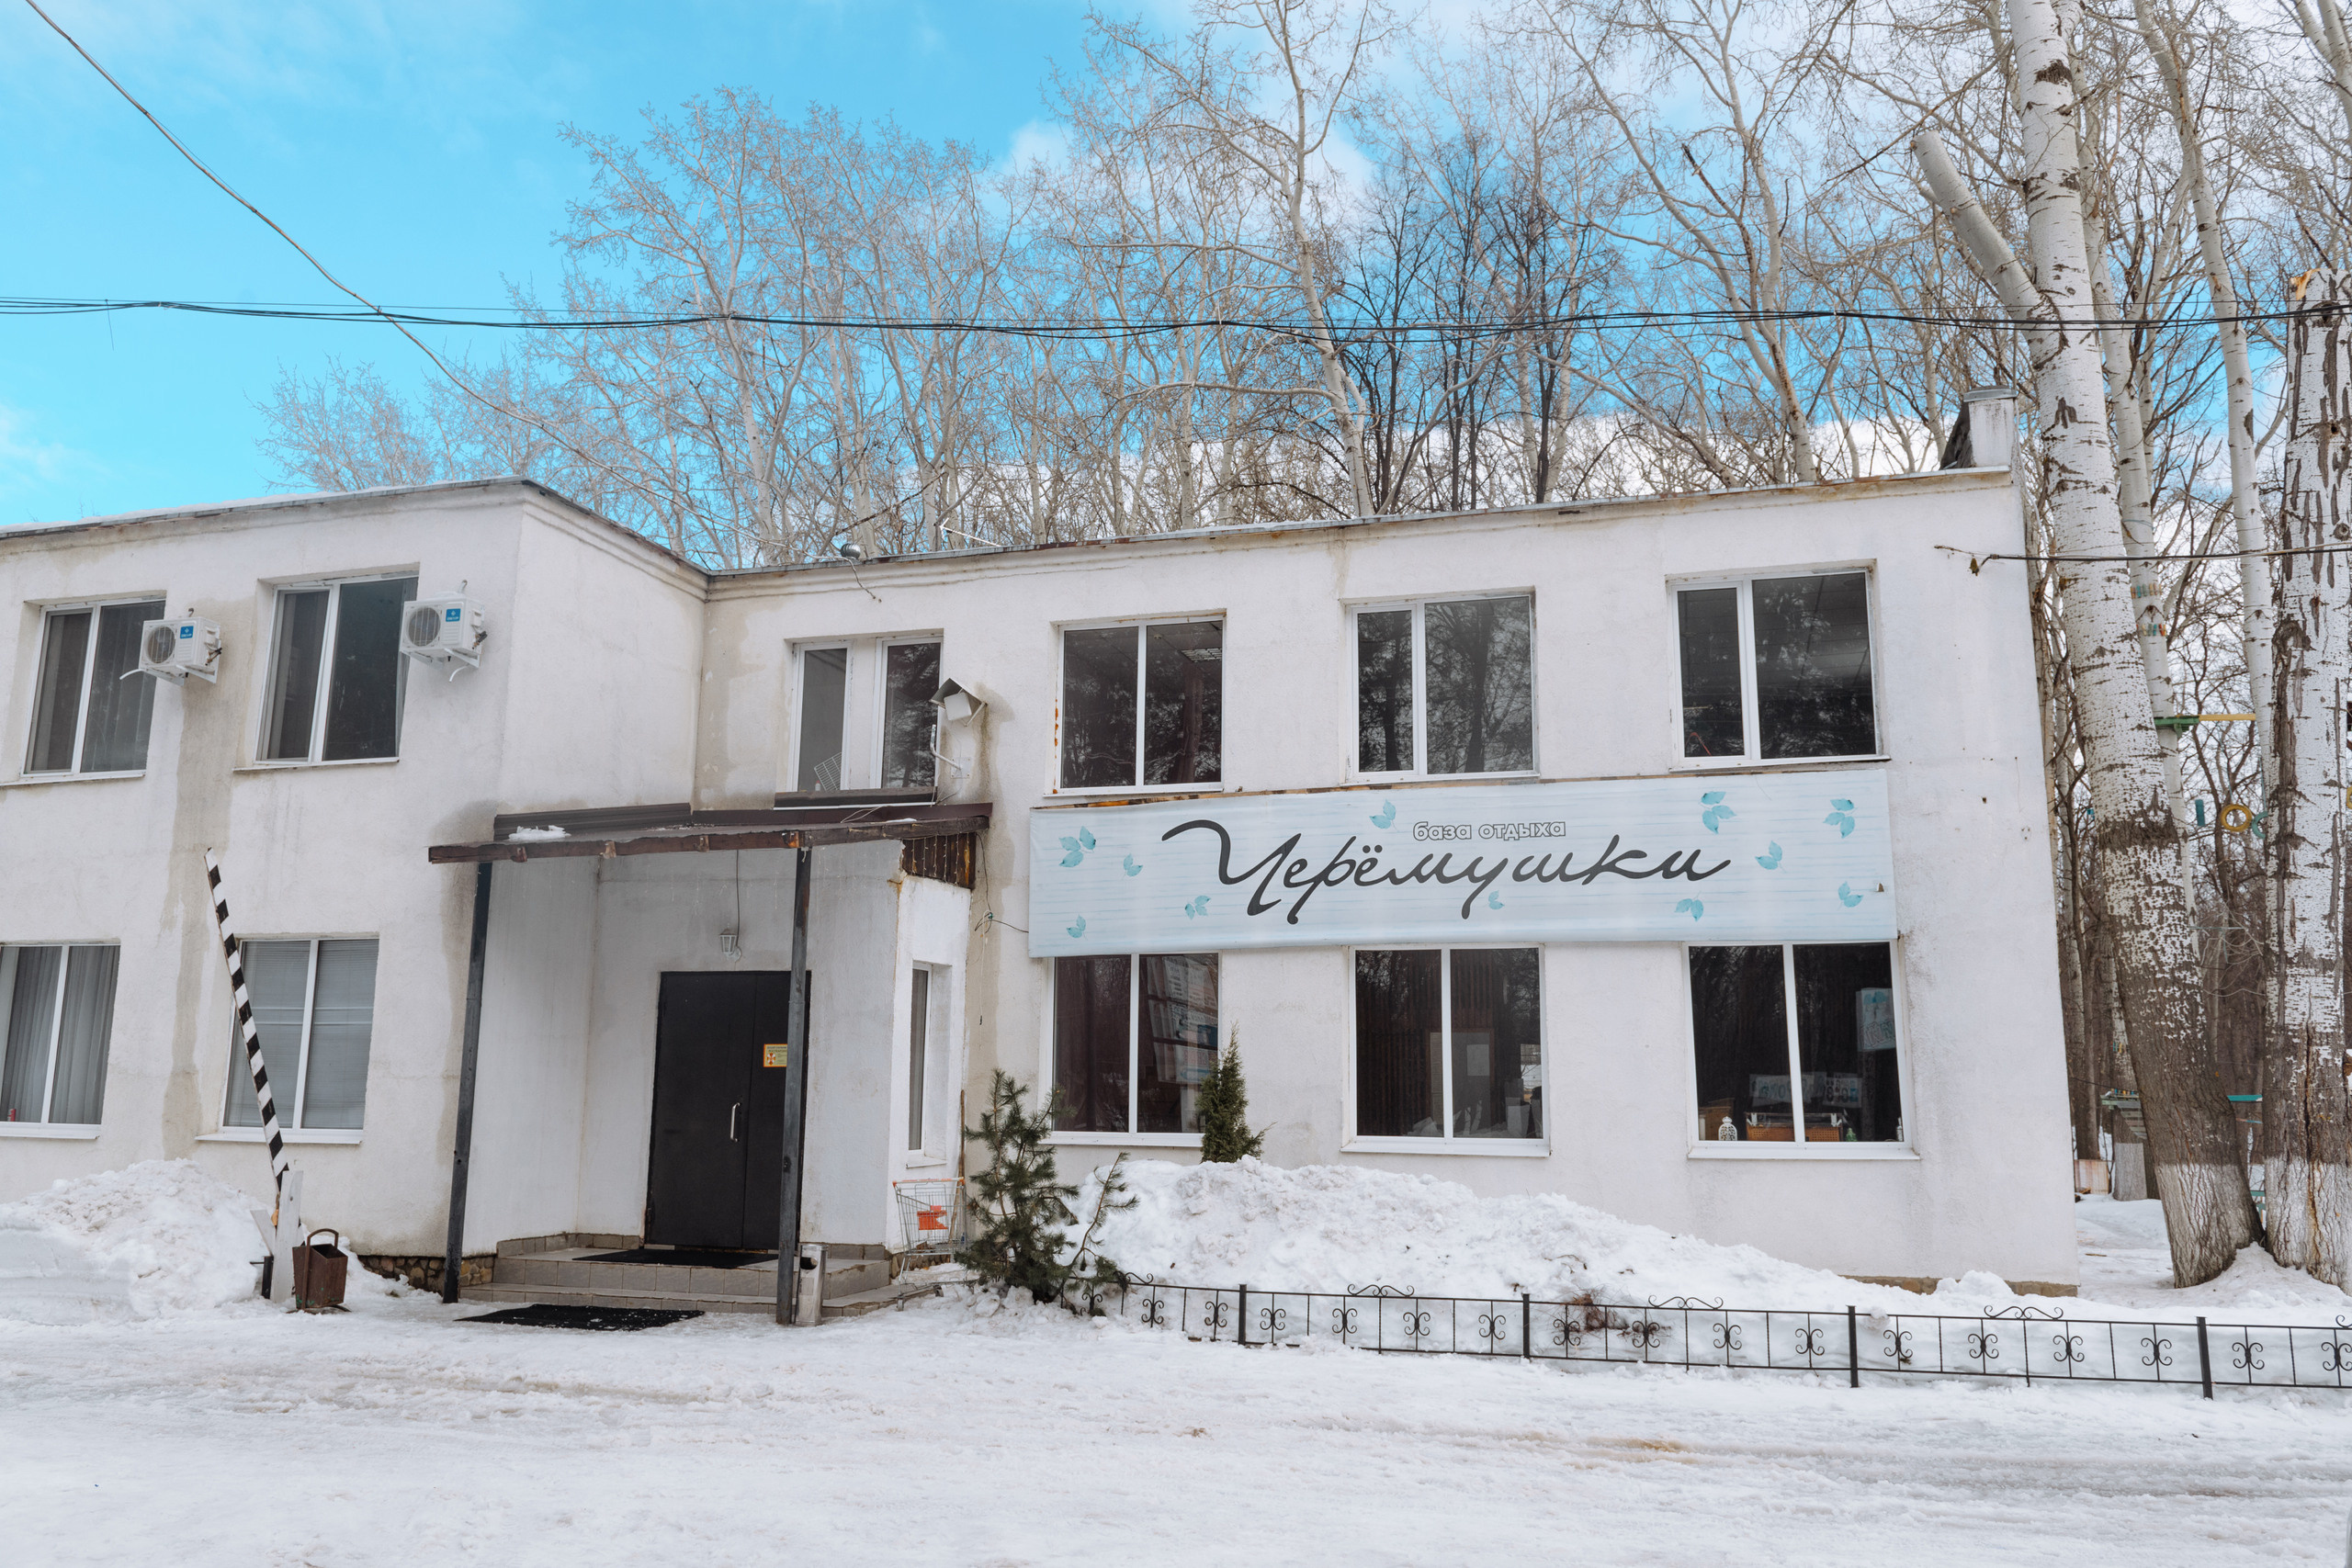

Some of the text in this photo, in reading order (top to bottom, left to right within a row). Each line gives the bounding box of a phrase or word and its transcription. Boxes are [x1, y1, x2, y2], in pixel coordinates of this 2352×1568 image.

[1413, 821, 1566, 840] база отдыха
[1161, 819, 1732, 925] Черёмушки
